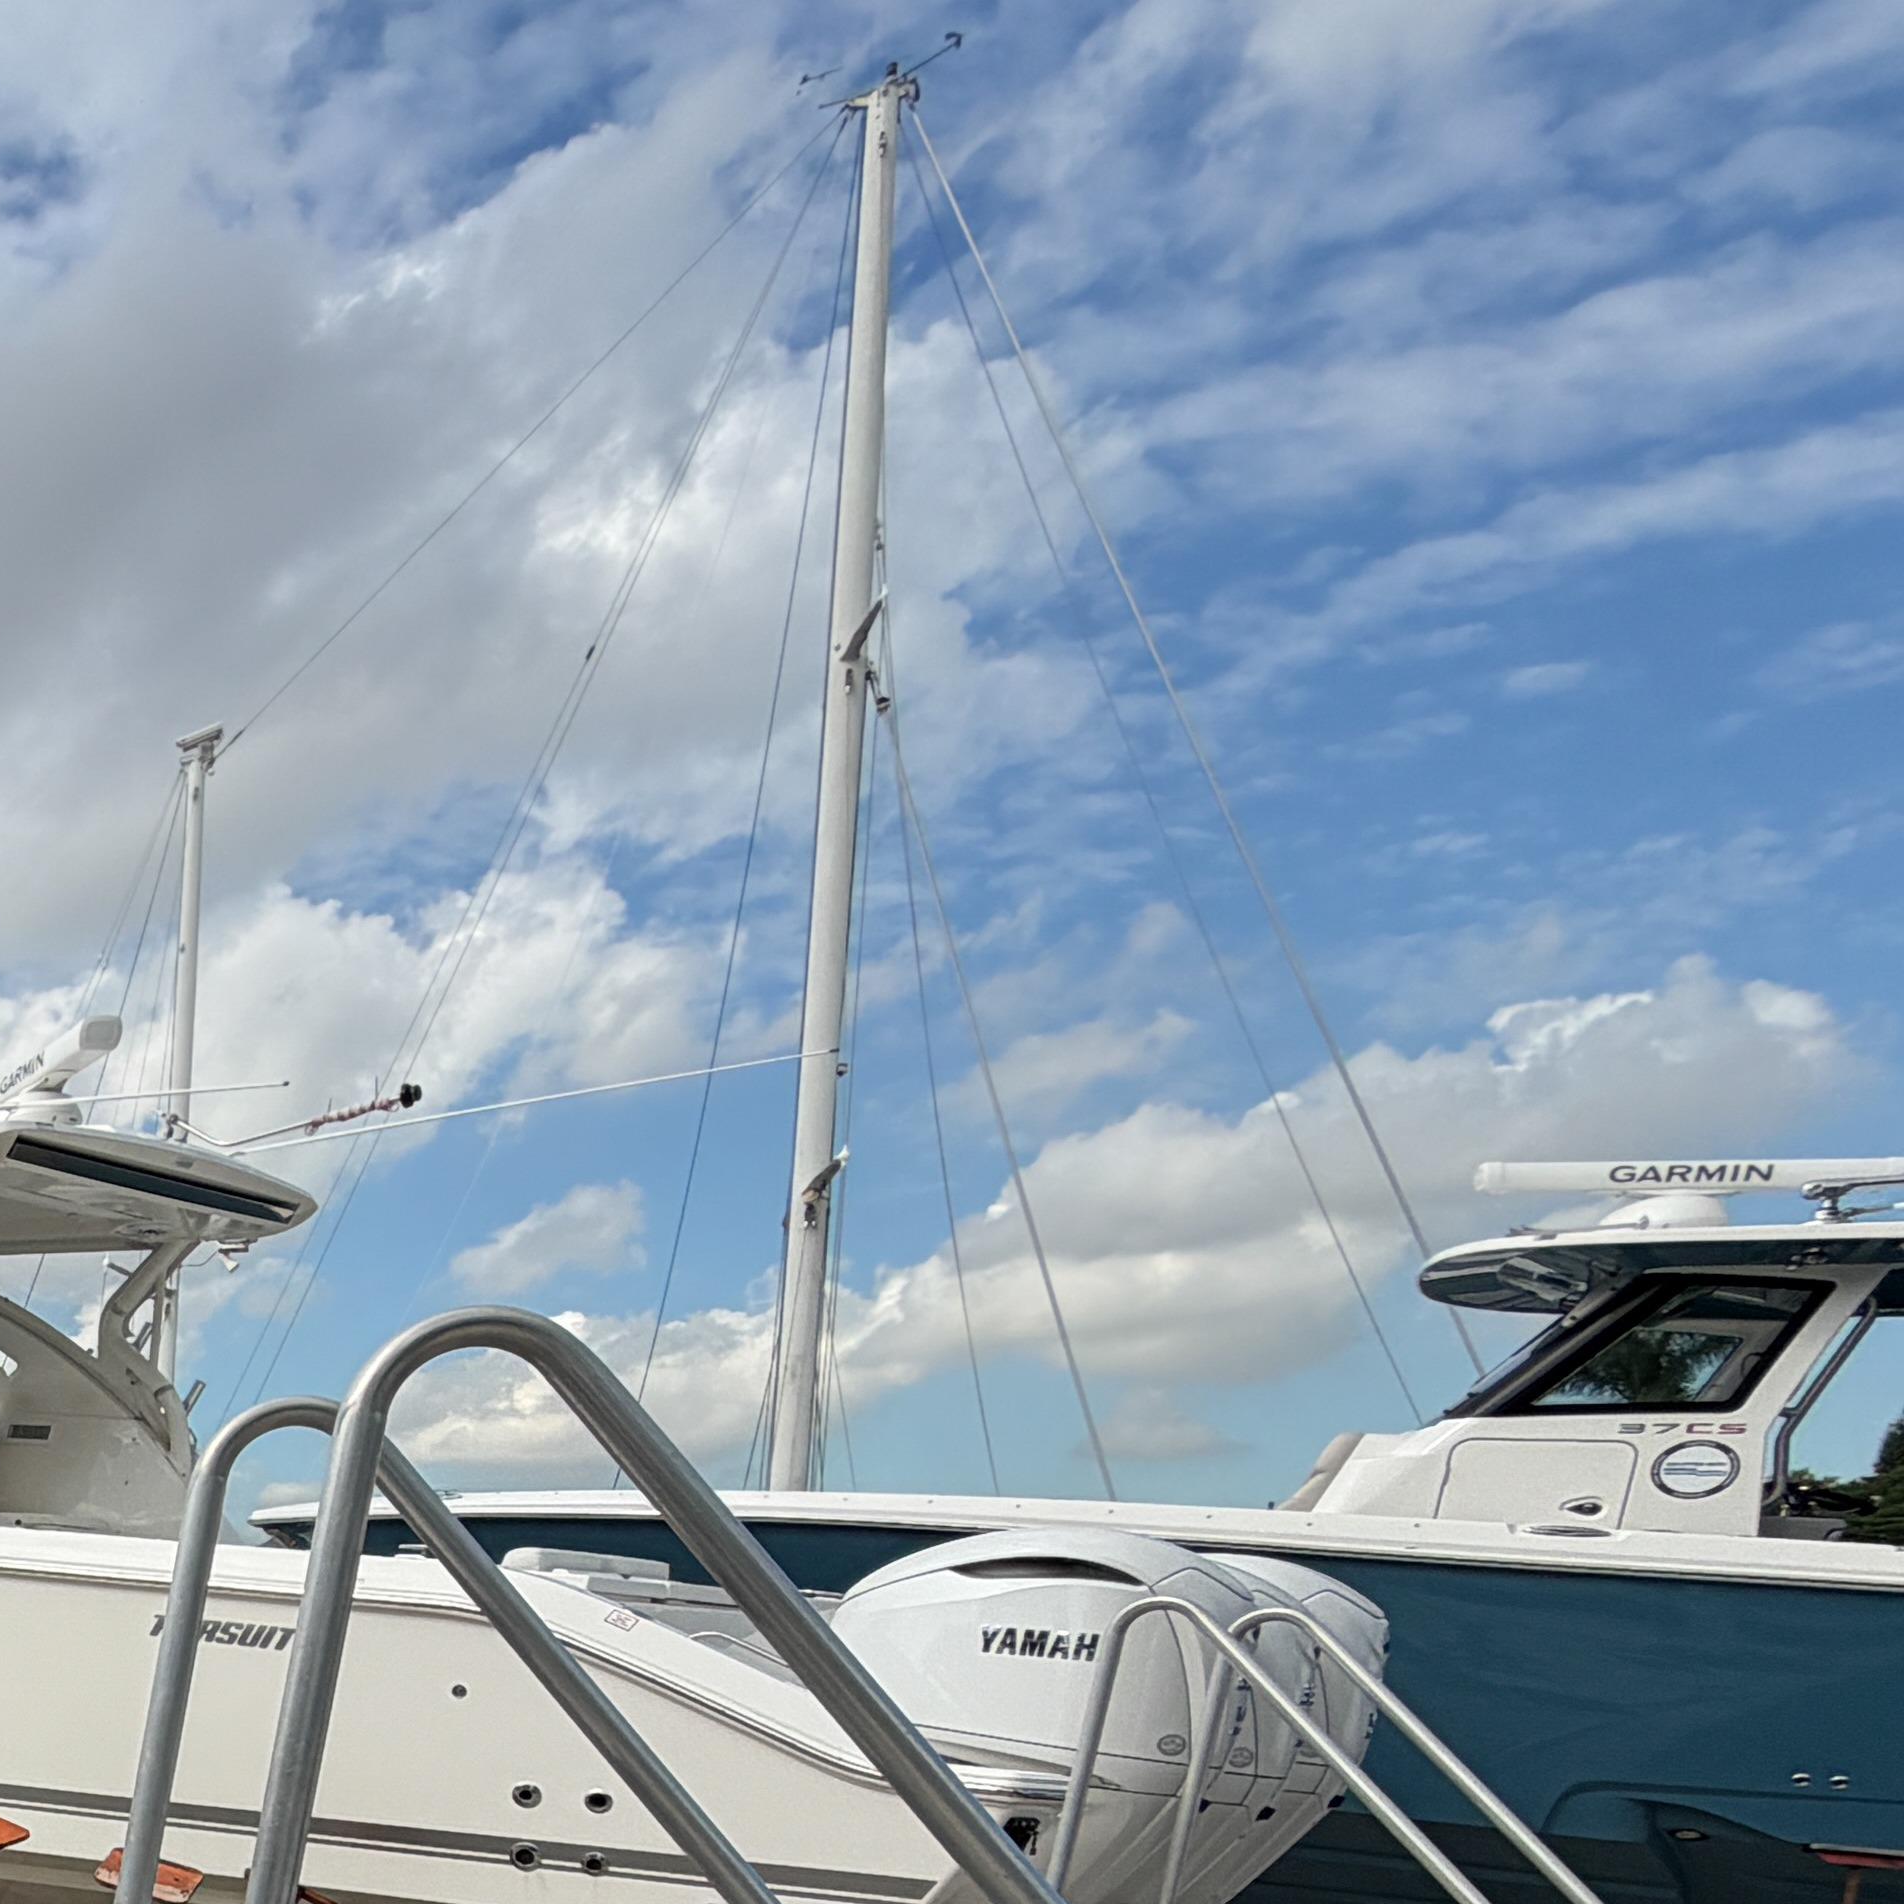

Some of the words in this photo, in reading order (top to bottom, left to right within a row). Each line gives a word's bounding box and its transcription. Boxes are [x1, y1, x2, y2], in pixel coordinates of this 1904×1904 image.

[1609, 1164, 1774, 1183] GARMIN
[1617, 1423, 1748, 1435] 37CS
[149, 1614, 296, 1651] RSUIT
[981, 1626, 1100, 1662] YAMAH
